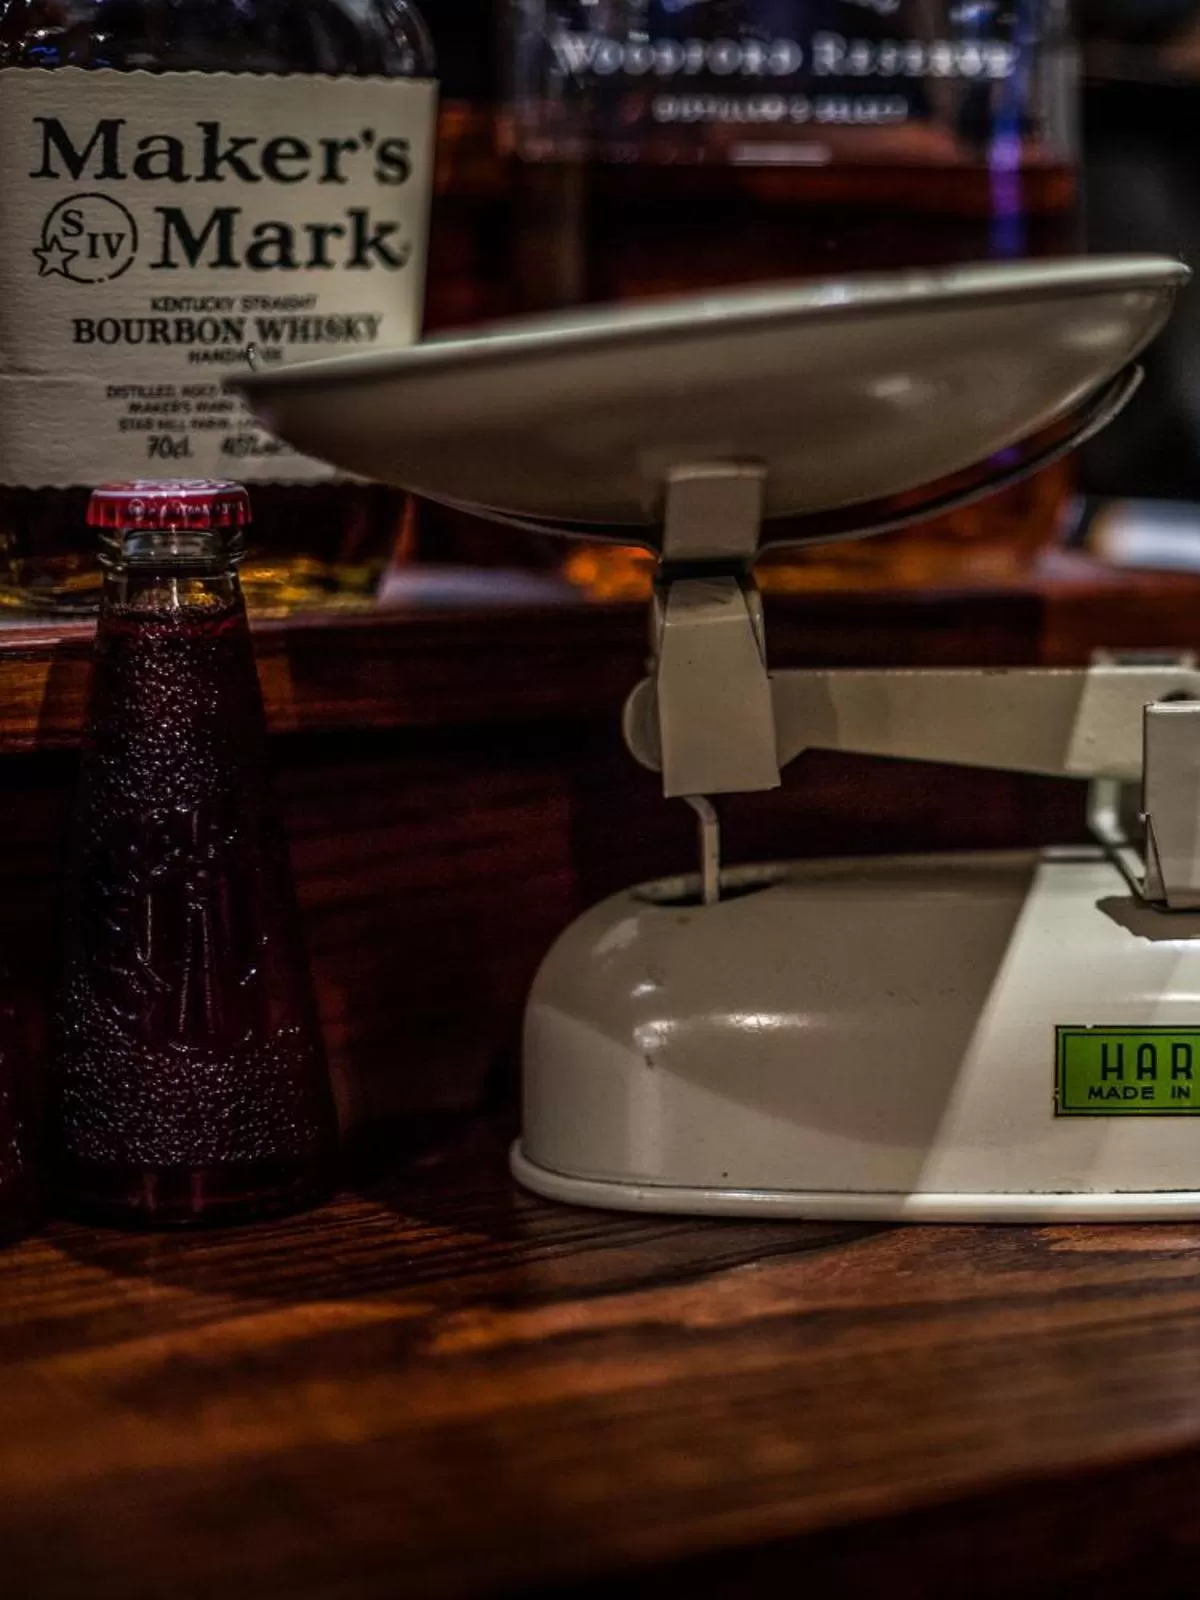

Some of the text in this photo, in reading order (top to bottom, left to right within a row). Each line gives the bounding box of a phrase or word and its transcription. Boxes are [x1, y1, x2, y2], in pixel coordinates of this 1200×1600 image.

[29, 117, 411, 186] Maker's
[149, 206, 410, 270] Mark
[150, 294, 319, 312] KENTUCKY STRAIGHT
[72, 313, 383, 345] BOURBON WHISKY
[1088, 1086, 1155, 1100] MADE
[1171, 1085, 1191, 1098] IN
